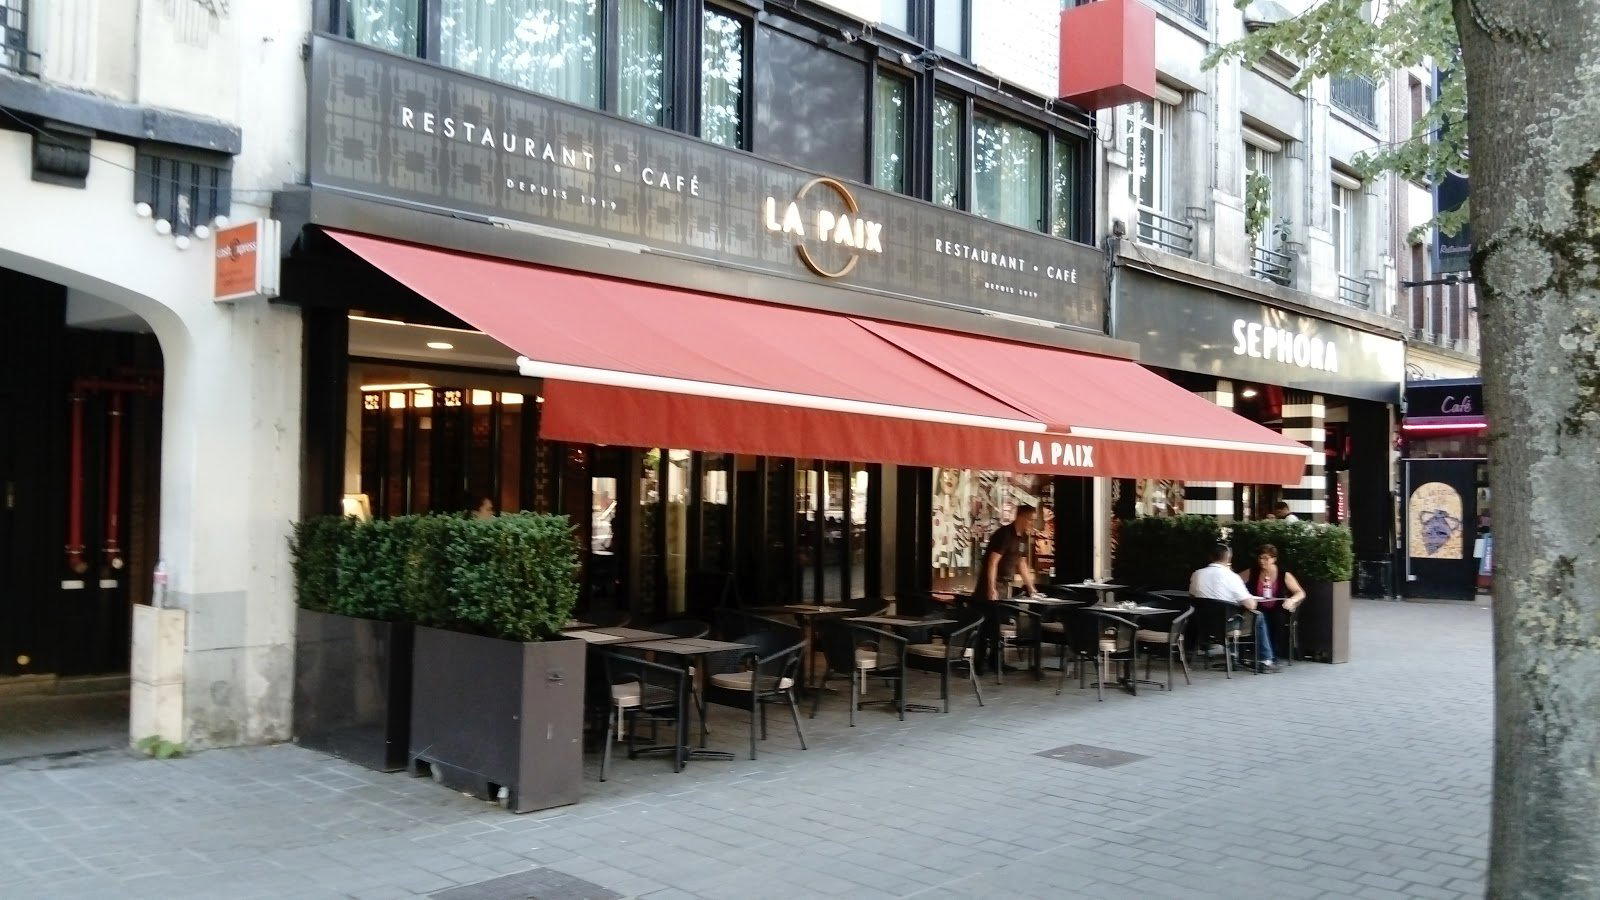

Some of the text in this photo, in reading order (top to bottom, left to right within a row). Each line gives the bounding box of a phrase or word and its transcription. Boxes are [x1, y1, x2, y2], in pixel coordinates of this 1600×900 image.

[401, 106, 700, 197] RESTAURANT CAFÉ
[506, 178, 617, 210] DEPUIS 1919
[765, 196, 882, 253] LA PAIX
[935, 238, 1077, 284] RESTAURANT CAFÉ
[1232, 319, 1338, 373] SEPHORA
[1441, 395, 1471, 413] Café
[1018, 439, 1094, 468] LA PAIX
